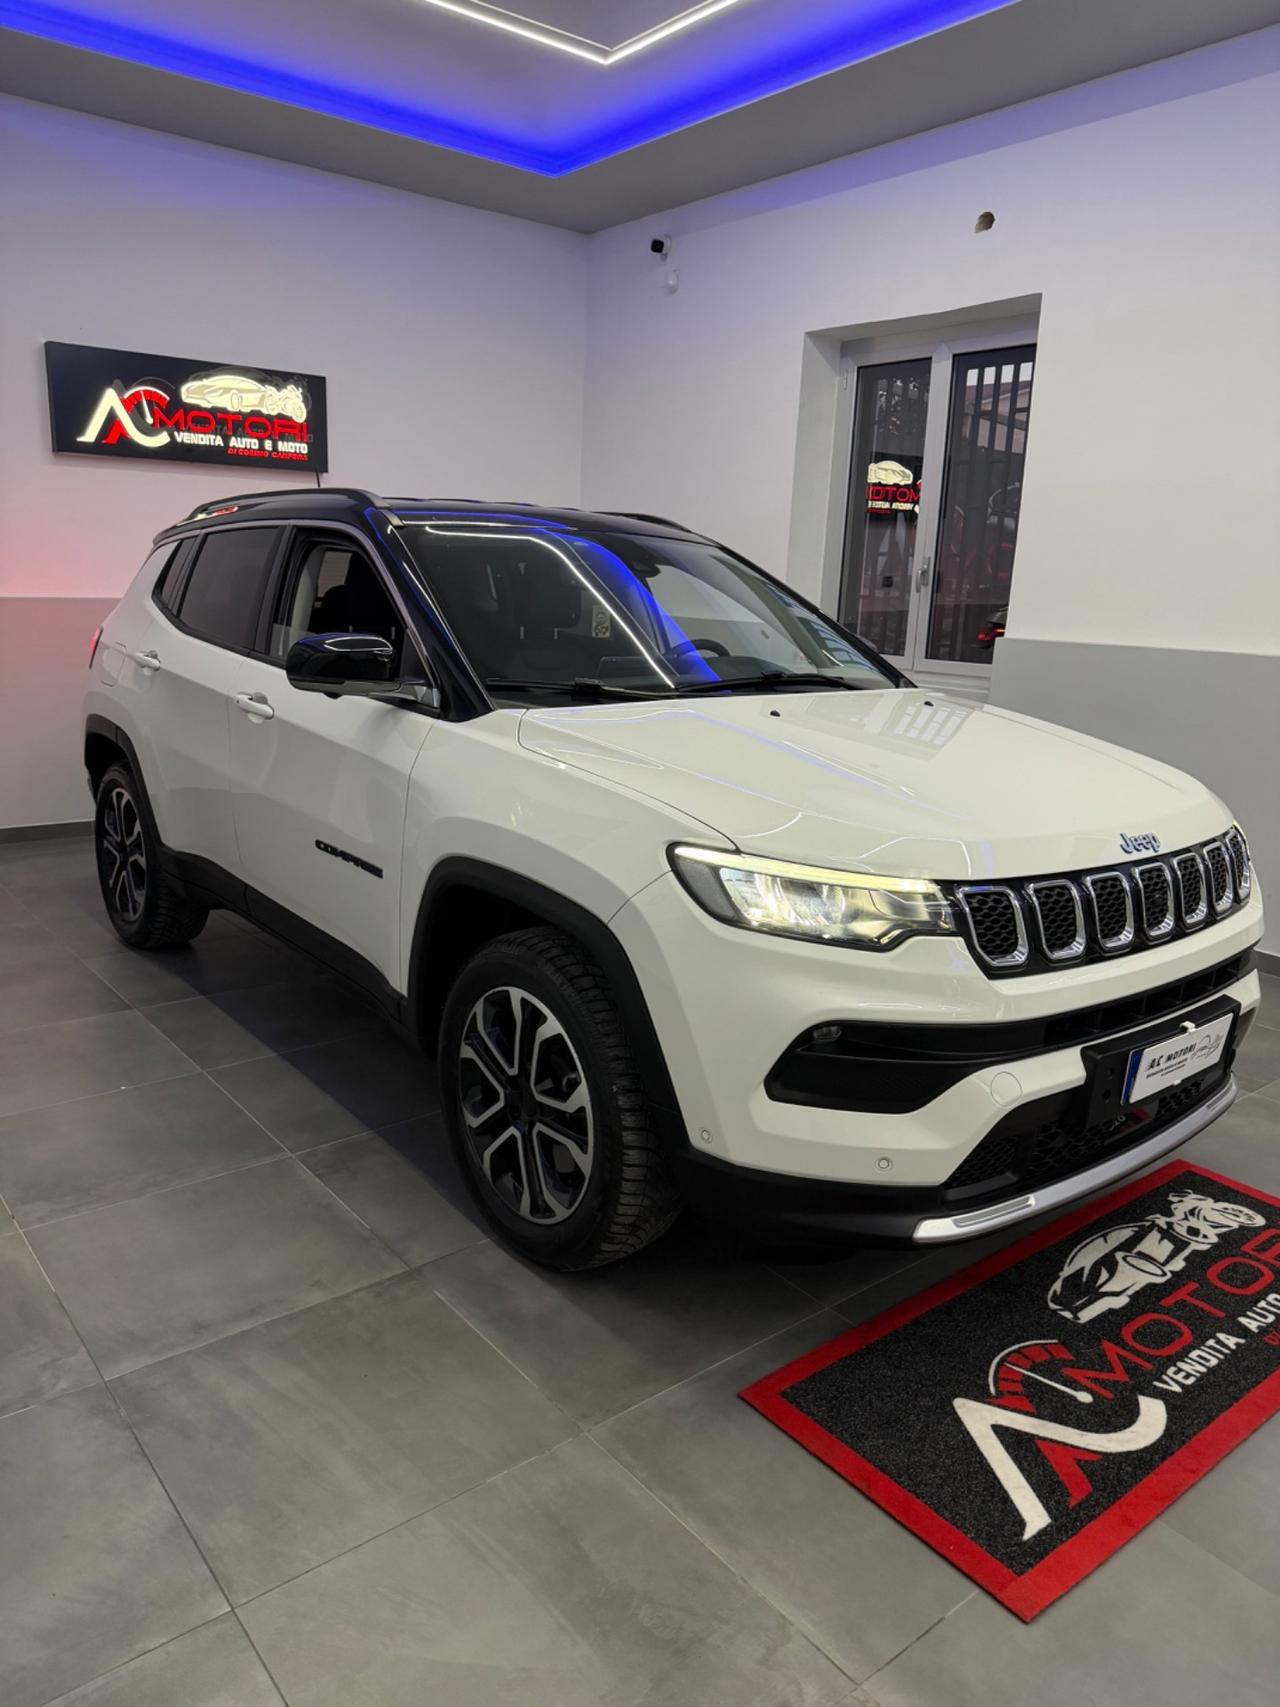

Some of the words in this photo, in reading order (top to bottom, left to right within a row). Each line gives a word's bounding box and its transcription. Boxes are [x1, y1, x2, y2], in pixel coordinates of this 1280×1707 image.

[174, 431, 224, 447] VENDITA
[229, 437, 259, 450] AUTO
[264, 440, 273, 451] E
[278, 441, 308, 454] MOTO
[1119, 832, 1160, 854] Jeep
[1165, 1042, 1197, 1063] MOTORI
[1153, 1333, 1246, 1393] VENDITA
